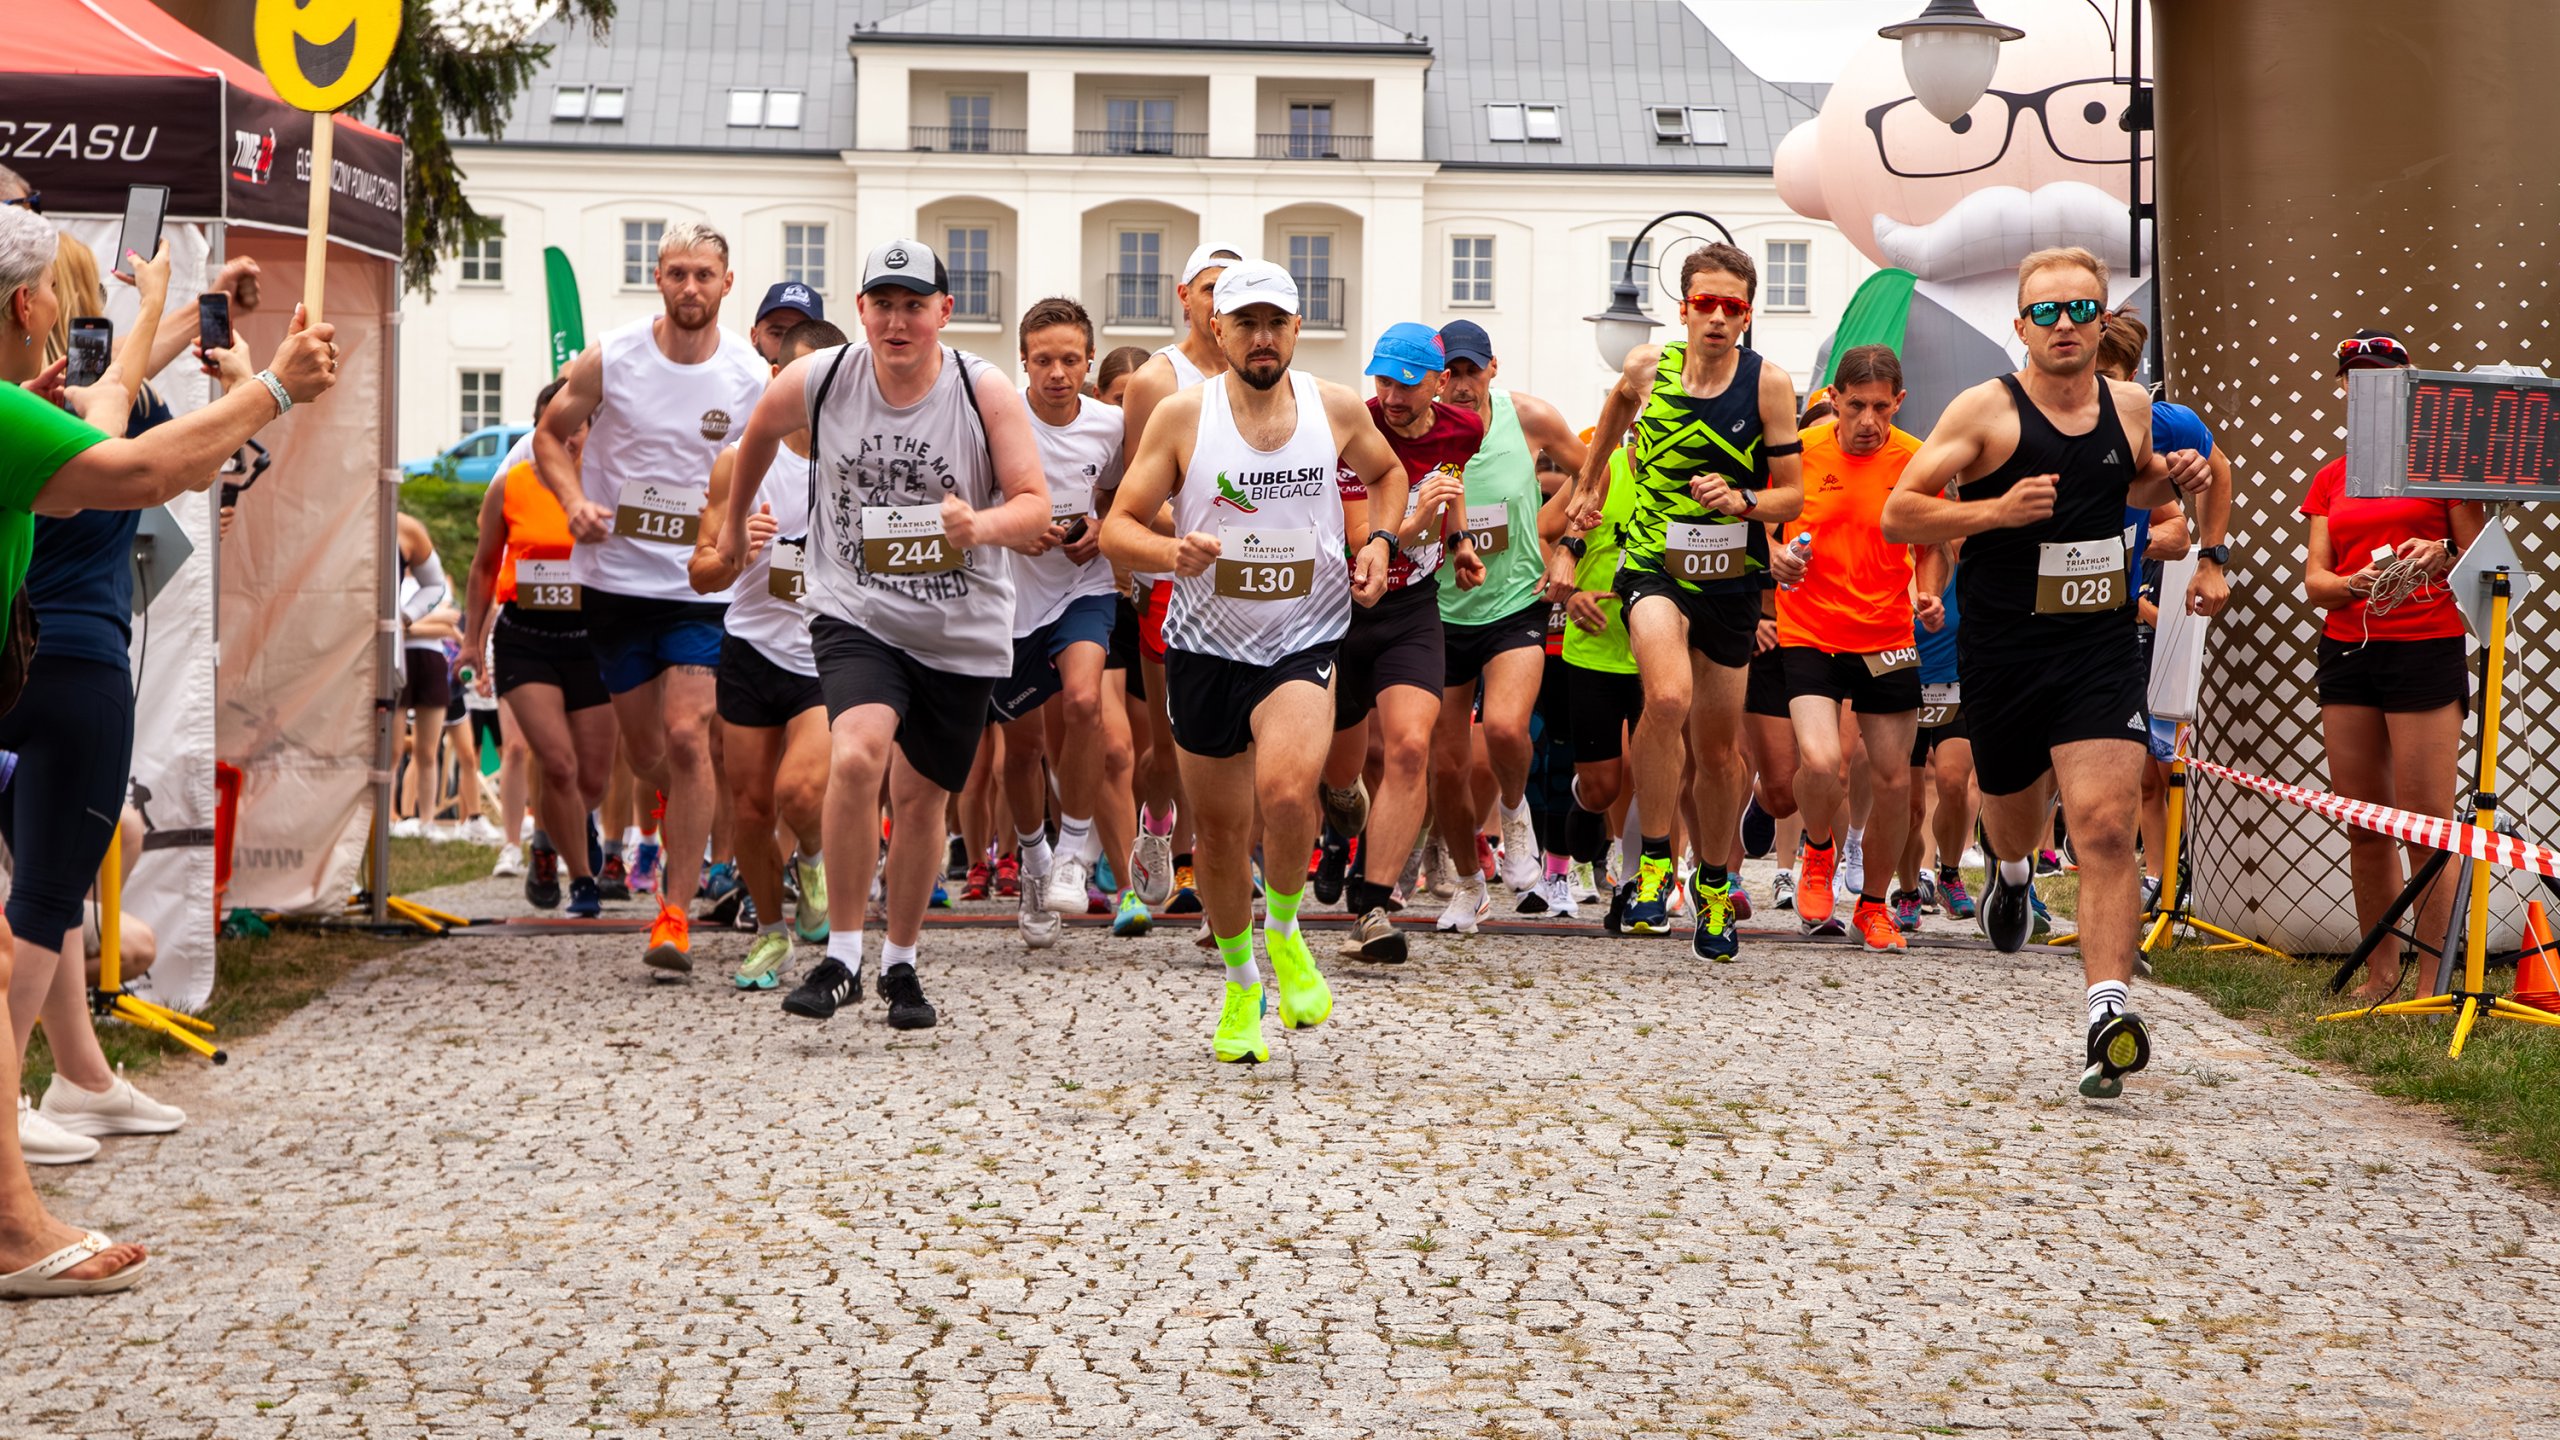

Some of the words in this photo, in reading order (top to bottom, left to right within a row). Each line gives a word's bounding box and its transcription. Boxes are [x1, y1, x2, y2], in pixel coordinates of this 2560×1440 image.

[860, 434, 882, 455] AT
[893, 435, 931, 459] THE
[1238, 467, 1324, 486] LUBELSKI
[642, 495, 687, 507] TRIATHLON
[1251, 482, 1323, 500] BIEGACZ
[636, 512, 685, 539] 118
[888, 520, 937, 528] TRIATHLON
[887, 539, 943, 567] 244
[1243, 545, 1295, 553] TRIATHLON
[1684, 553, 1730, 575] 010
[2066, 556, 2111, 566] TRIATHLON
[1239, 566, 1295, 593] 130
[533, 585, 574, 605] 133
[2061, 577, 2111, 606] 028
